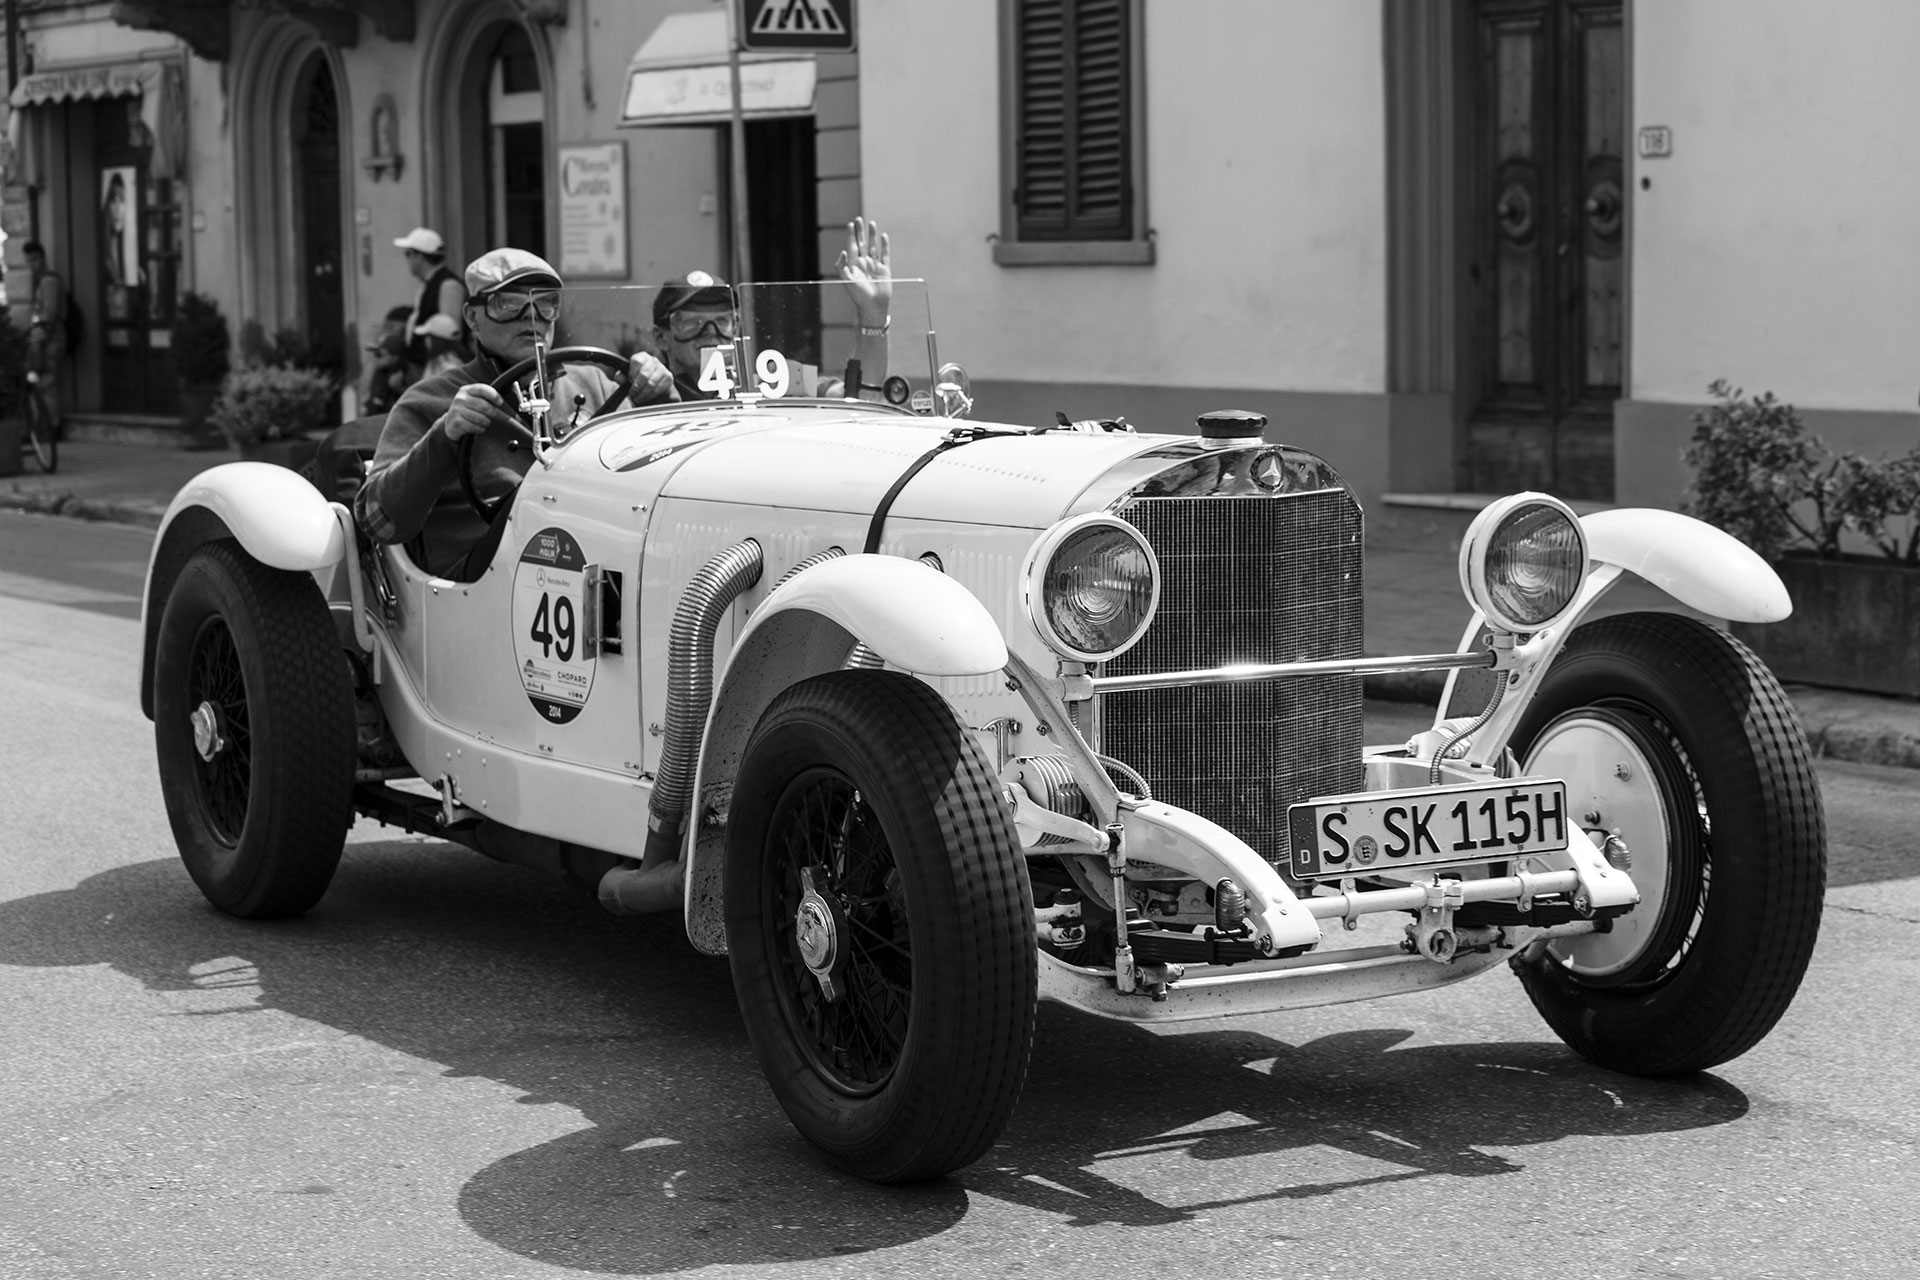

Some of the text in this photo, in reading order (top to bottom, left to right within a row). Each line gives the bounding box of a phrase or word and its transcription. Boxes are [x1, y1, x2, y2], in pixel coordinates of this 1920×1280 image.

[640, 420, 740, 437] 49
[649, 448, 673, 462] 2014
[541, 538, 556, 548] 1000
[539, 548, 555, 558] MIGLIA
[531, 592, 575, 662] 49
[557, 671, 587, 685] CHOPARD
[548, 705, 562, 719] 2014
[1322, 812, 1350, 865] S
[1451, 791, 1564, 852] 115H
[1300, 849, 1312, 865] D
